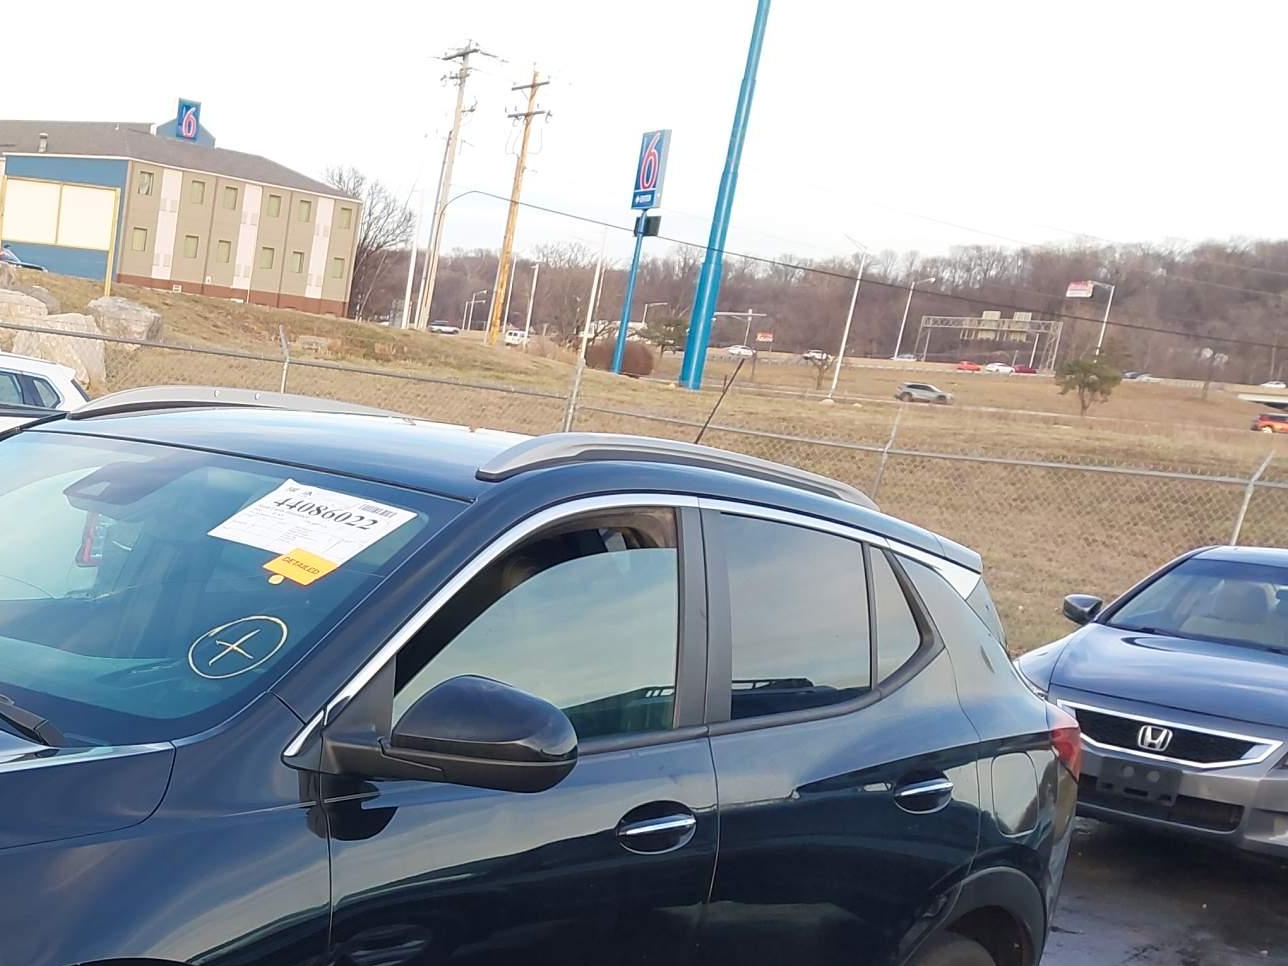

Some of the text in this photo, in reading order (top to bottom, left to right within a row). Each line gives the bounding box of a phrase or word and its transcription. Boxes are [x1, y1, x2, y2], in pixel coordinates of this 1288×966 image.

[182, 106, 197, 138] 6
[639, 131, 661, 191] 6
[272, 495, 380, 531] 44086022
